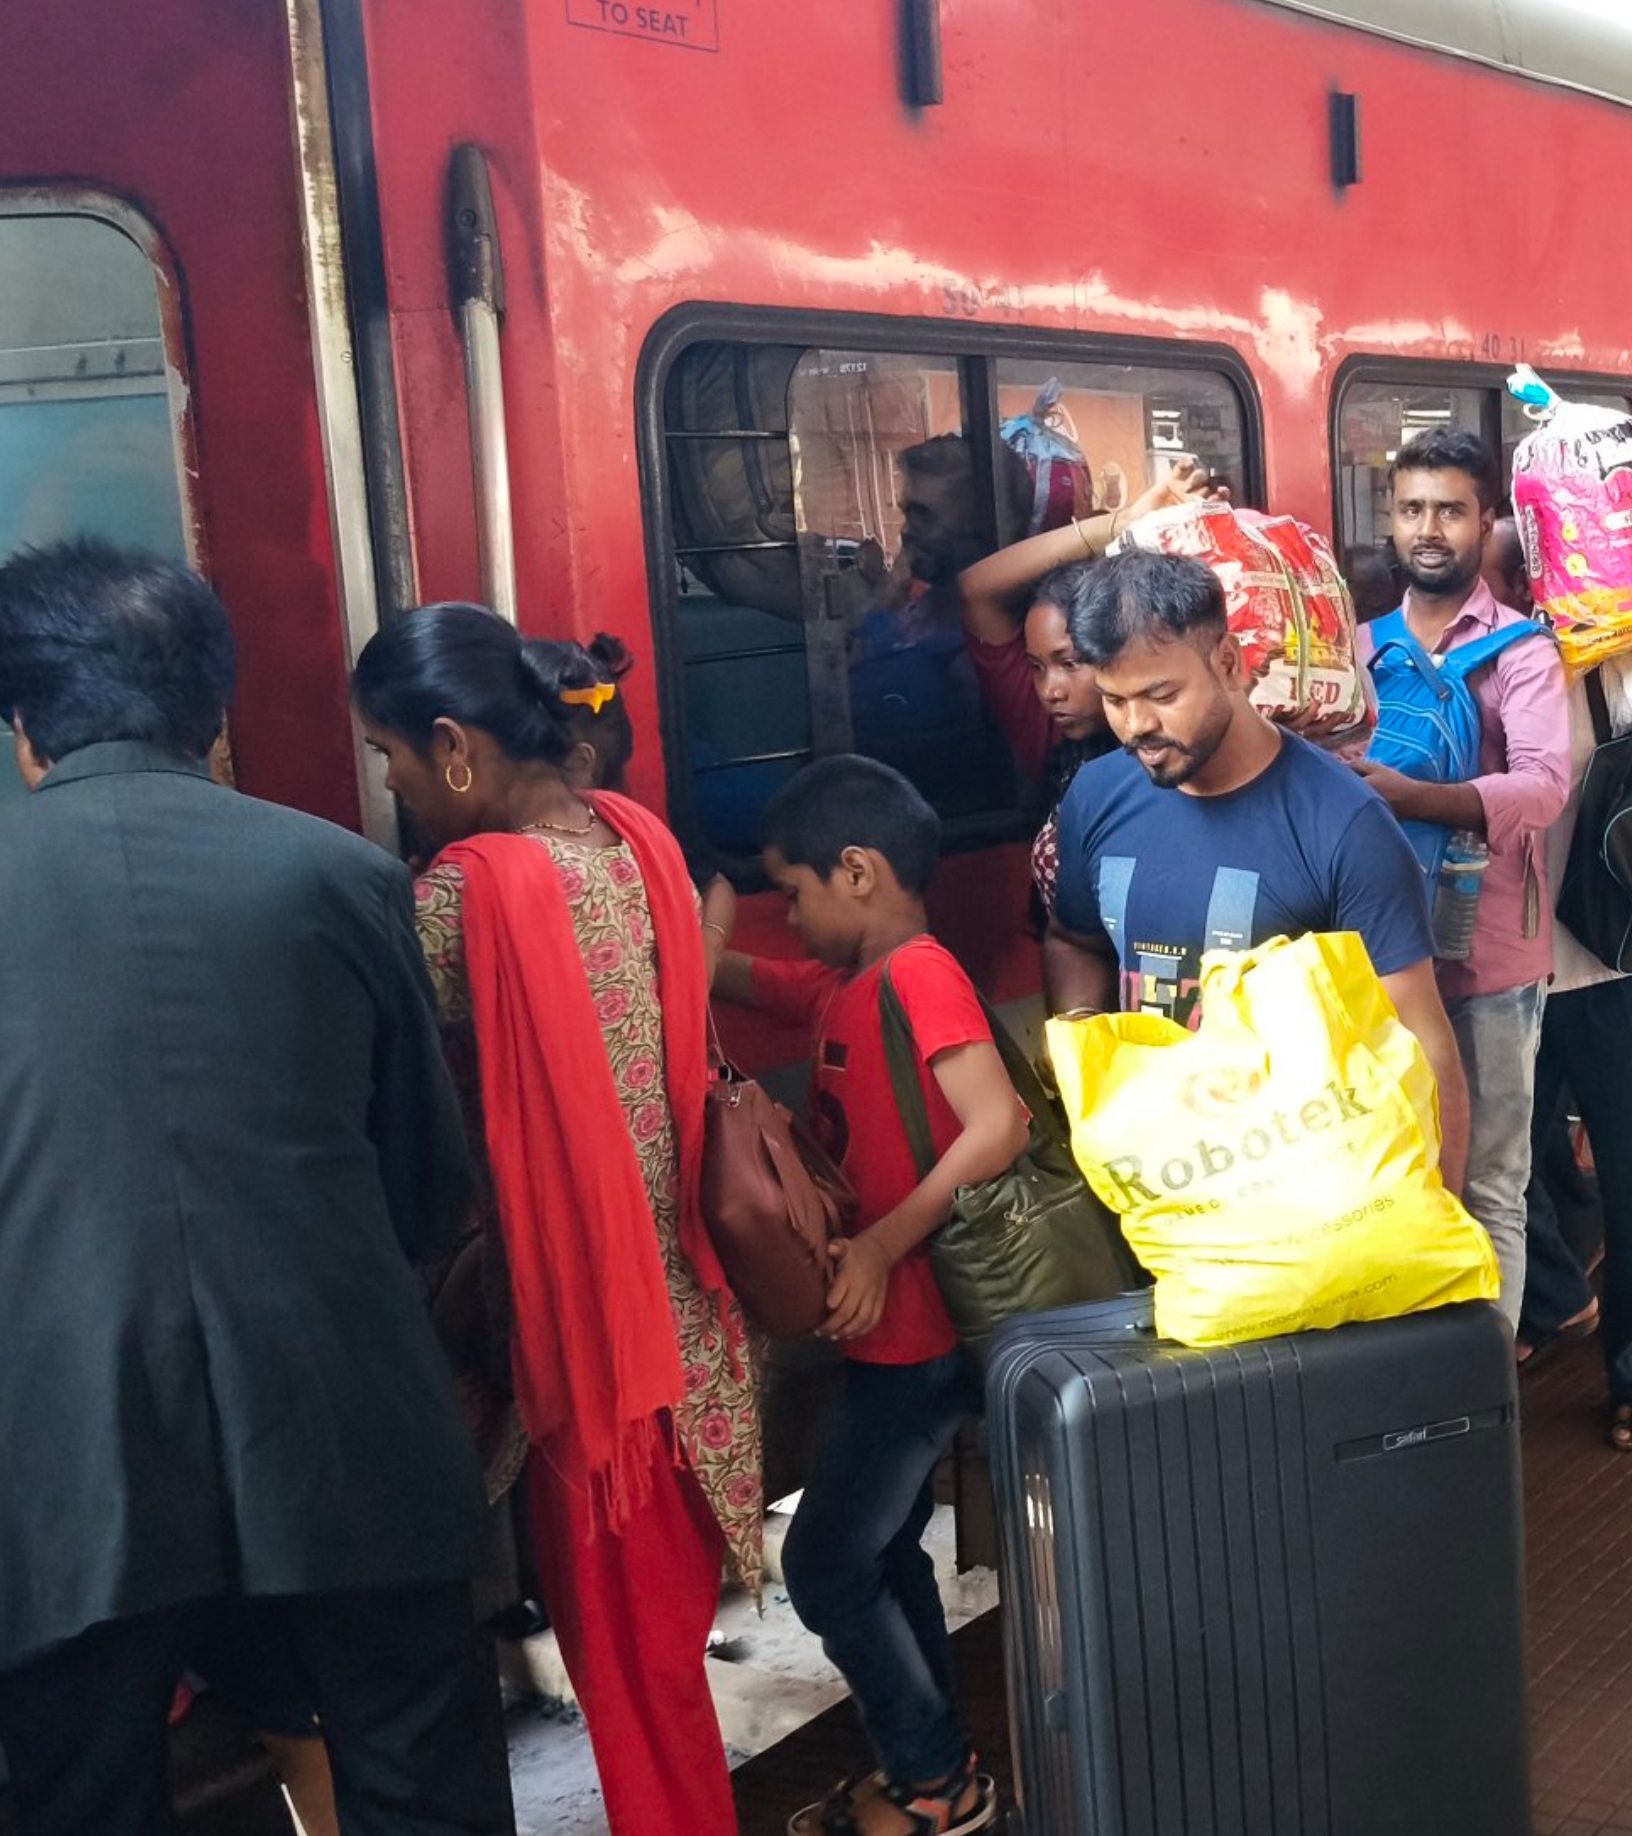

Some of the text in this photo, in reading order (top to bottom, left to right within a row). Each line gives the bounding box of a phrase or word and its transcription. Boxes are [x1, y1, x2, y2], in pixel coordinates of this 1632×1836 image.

[597, 0, 688, 37] TO SEAT
[1103, 1081, 1374, 1211] Robotek
